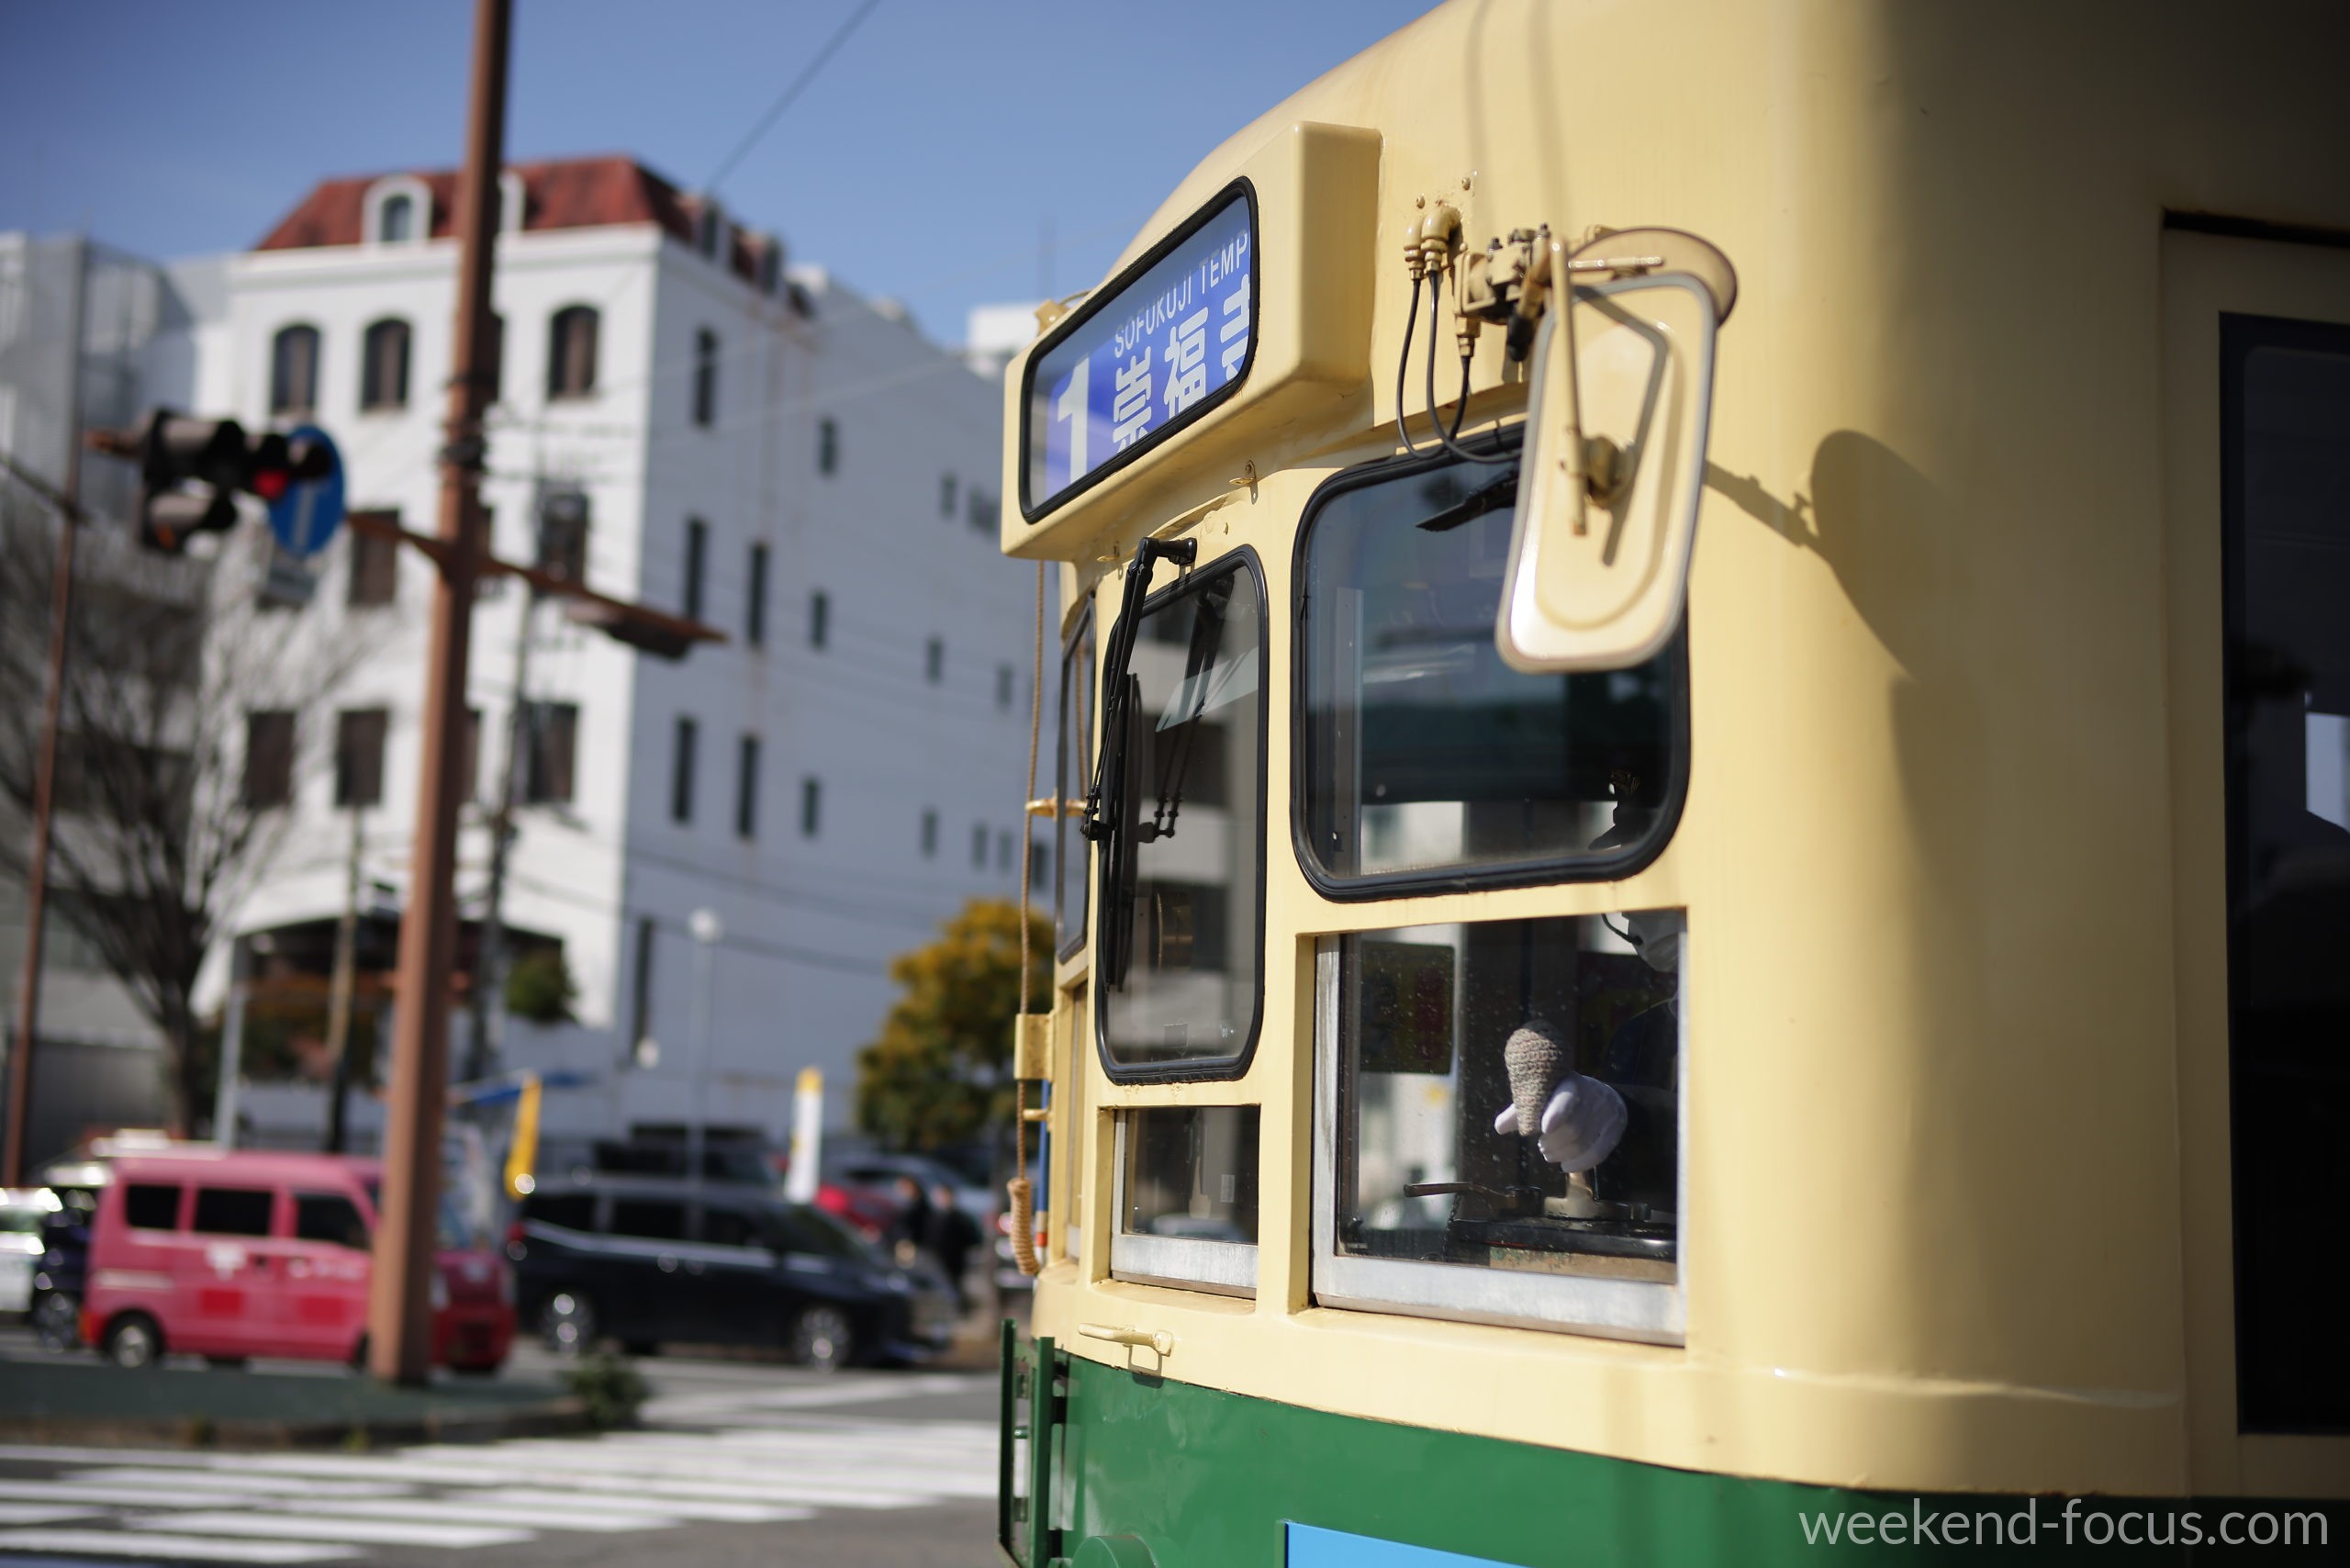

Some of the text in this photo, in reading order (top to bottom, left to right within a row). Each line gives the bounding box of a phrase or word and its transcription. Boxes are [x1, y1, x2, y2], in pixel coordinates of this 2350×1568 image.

[1114, 229, 1250, 358] SOFUKUJI TEMP
[1058, 352, 1090, 485] 1
